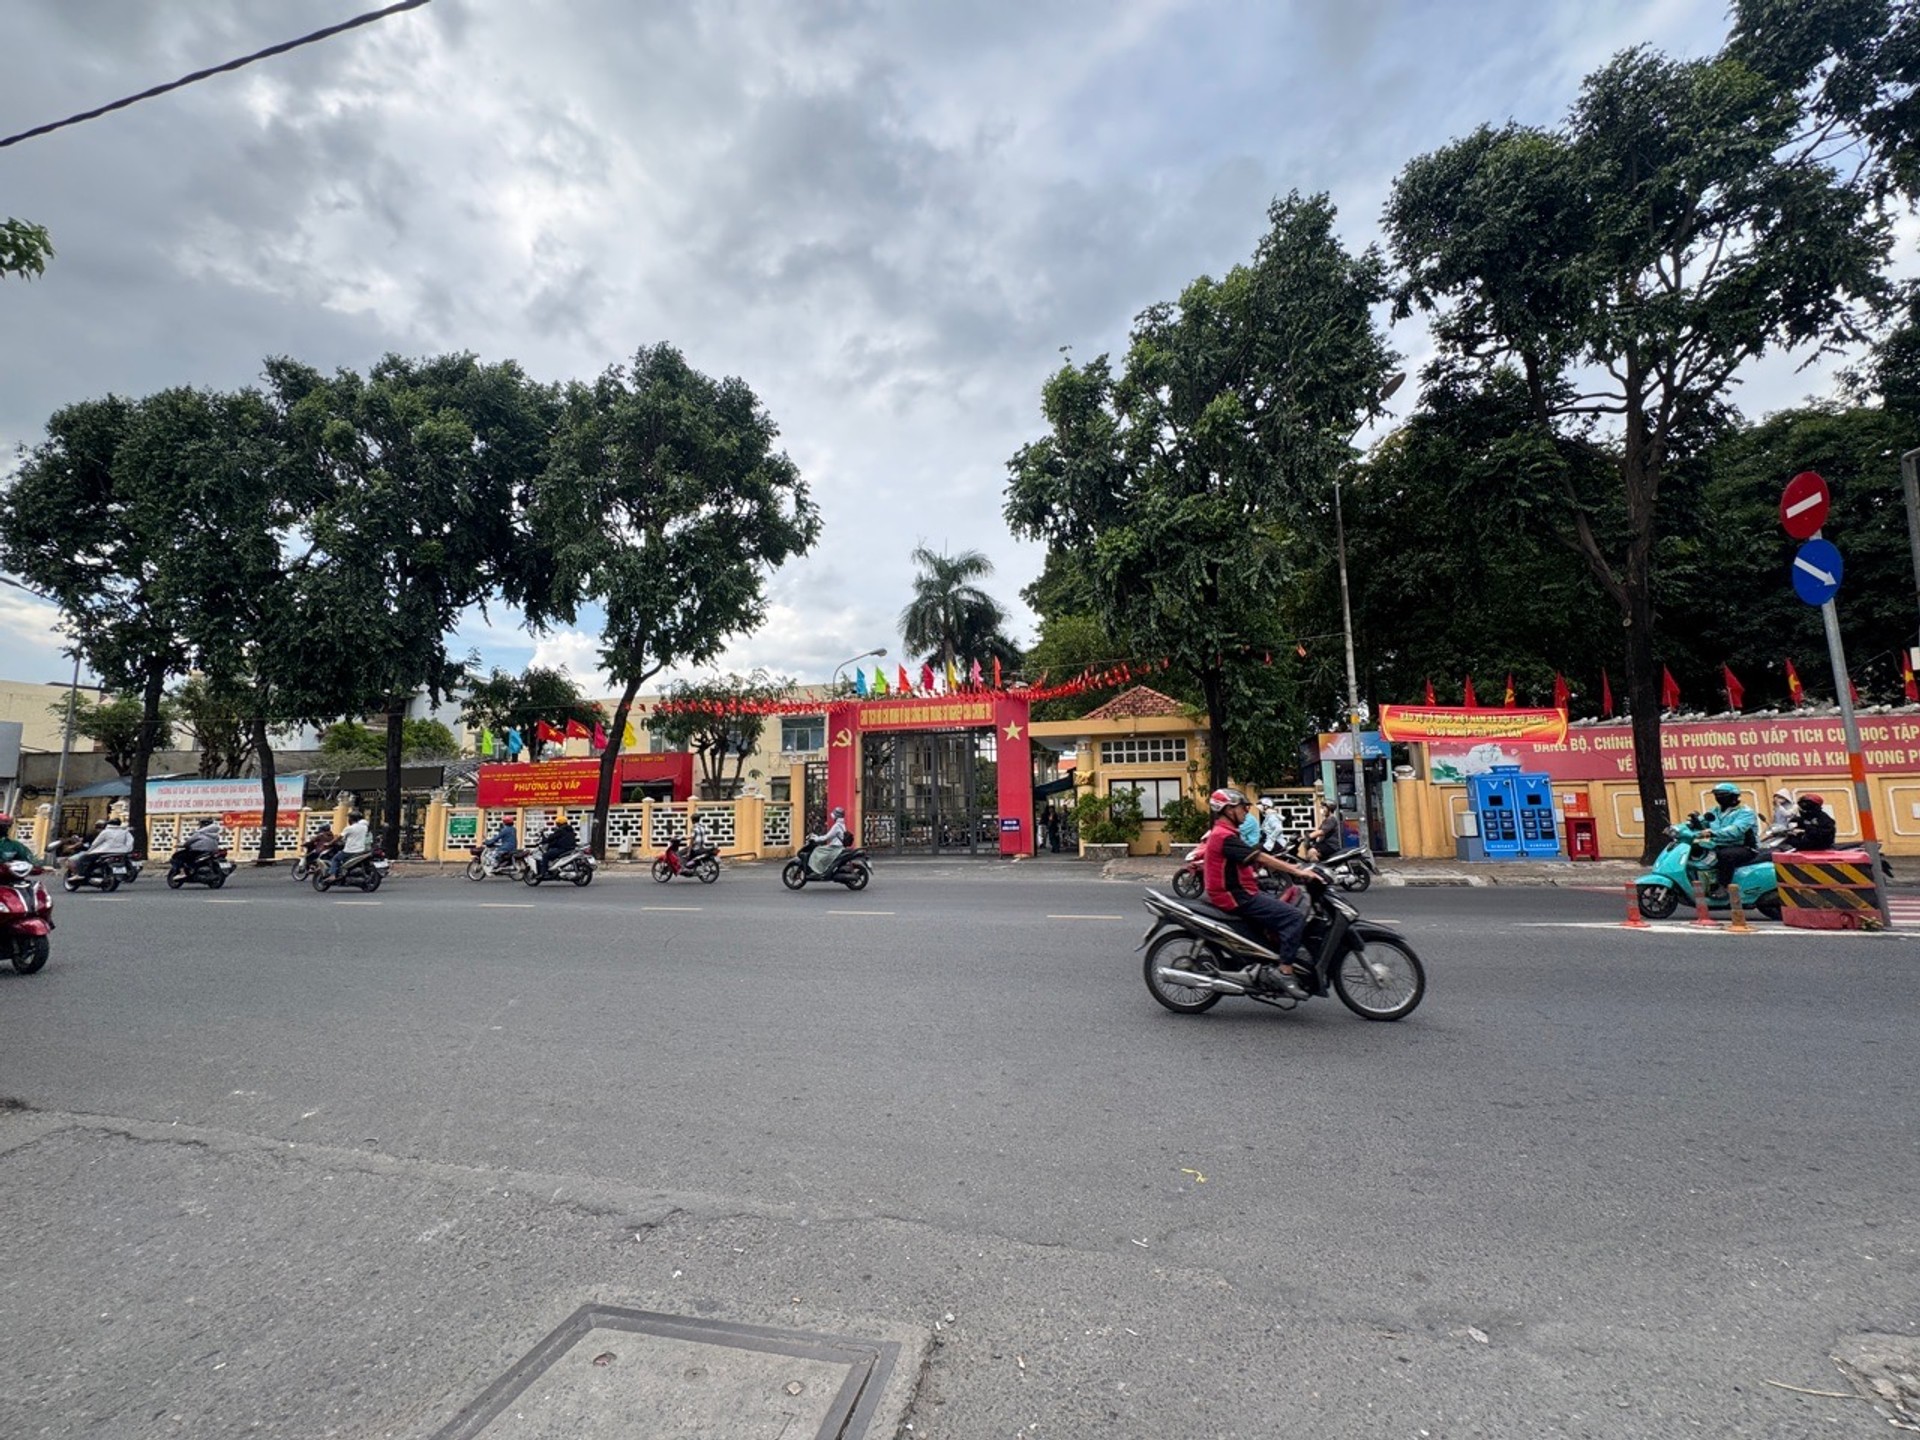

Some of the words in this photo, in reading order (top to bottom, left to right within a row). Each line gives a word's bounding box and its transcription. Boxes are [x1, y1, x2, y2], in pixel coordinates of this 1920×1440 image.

[1327, 737, 1365, 756] Viki
[1569, 735, 1592, 754] BỘ,
[1594, 734, 1634, 751] CHÍNH
[1681, 729, 1737, 747] PHƯỜNG
[1740, 727, 1758, 745] GÒ
[1761, 725, 1788, 744] VẤP
[1791, 726, 1824, 743] TÍCH
[1859, 726, 1889, 744] HỌC
[1891, 722, 1920, 743] TẬP
[1661, 753, 1678, 771] HÍ
[1680, 755, 1698, 773] TỰ
[1700, 754, 1730, 773] LỰC,
[1732, 753, 1750, 772] TỰ
[1753, 750, 1801, 768] CƯỜNG
[1803, 749, 1823, 767] VÀ
[1825, 751, 1850, 766] KH
[1865, 750, 1906, 768] VỌNG
[1908, 749, 1920, 764] P
